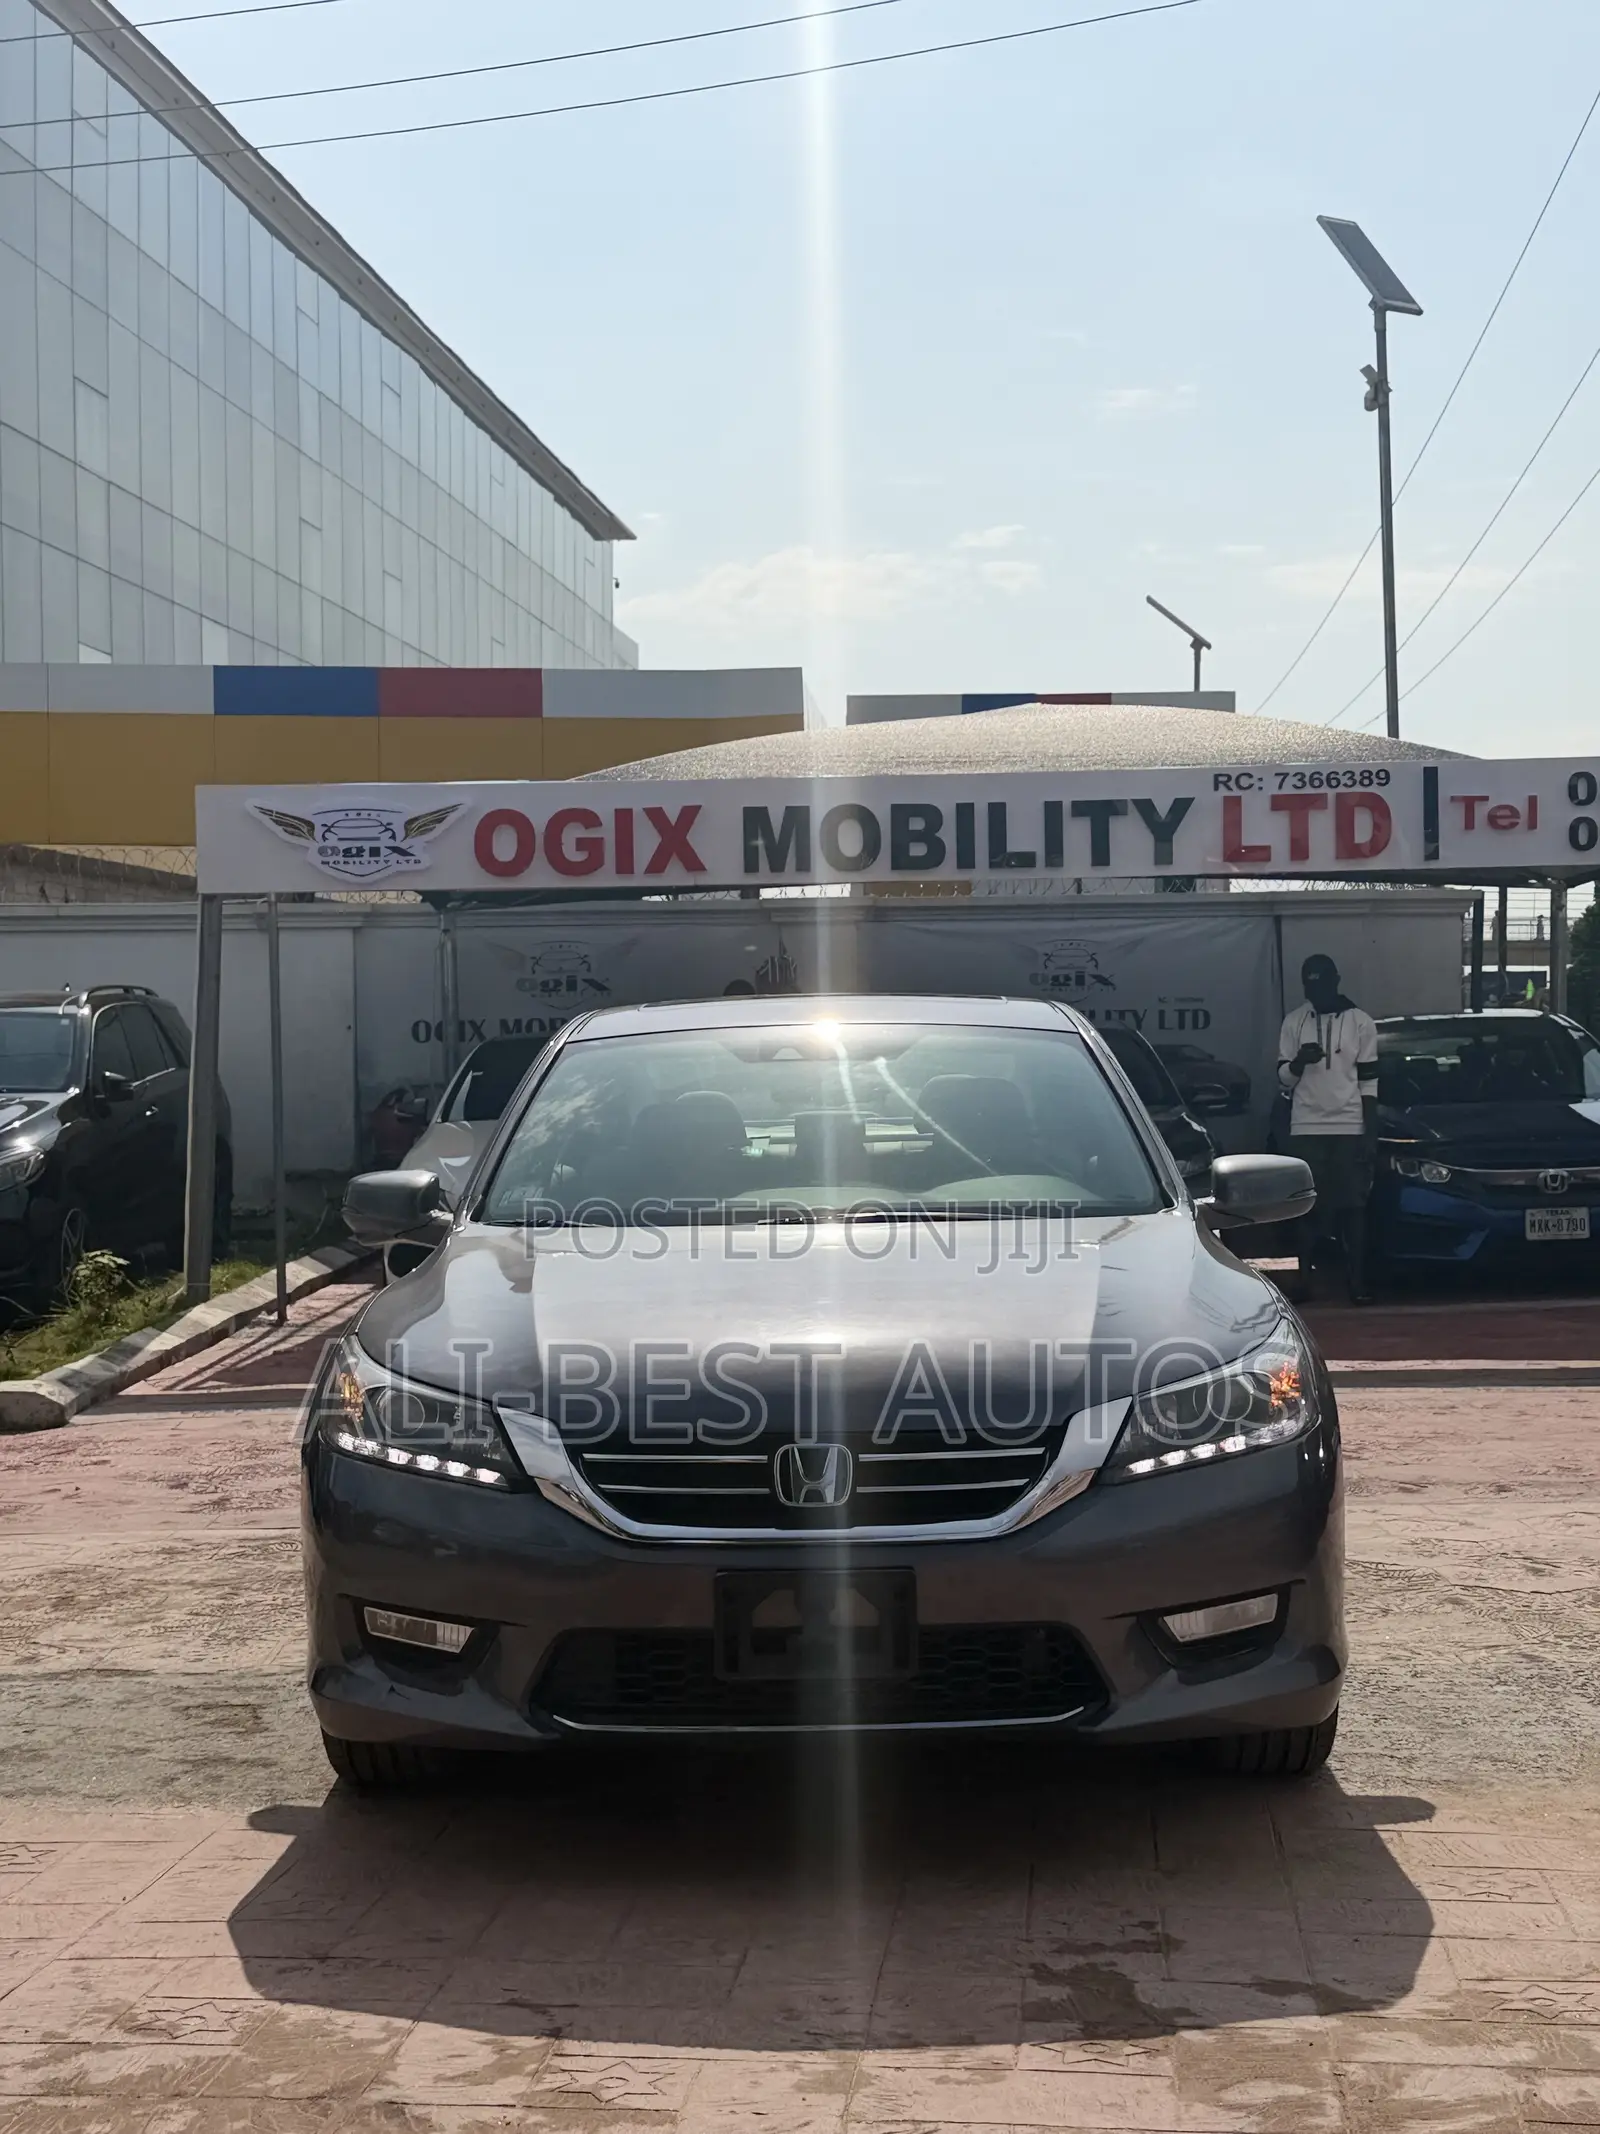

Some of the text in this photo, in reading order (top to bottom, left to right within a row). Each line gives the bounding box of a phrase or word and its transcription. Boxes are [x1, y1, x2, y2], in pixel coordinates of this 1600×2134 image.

[1213, 768, 1391, 791] RC: 7366389
[1450, 795, 1538, 831] Tel
[474, 791, 1393, 878] OGIX MOBILITY LTD
[1158, 1008, 1211, 1031] LTD
